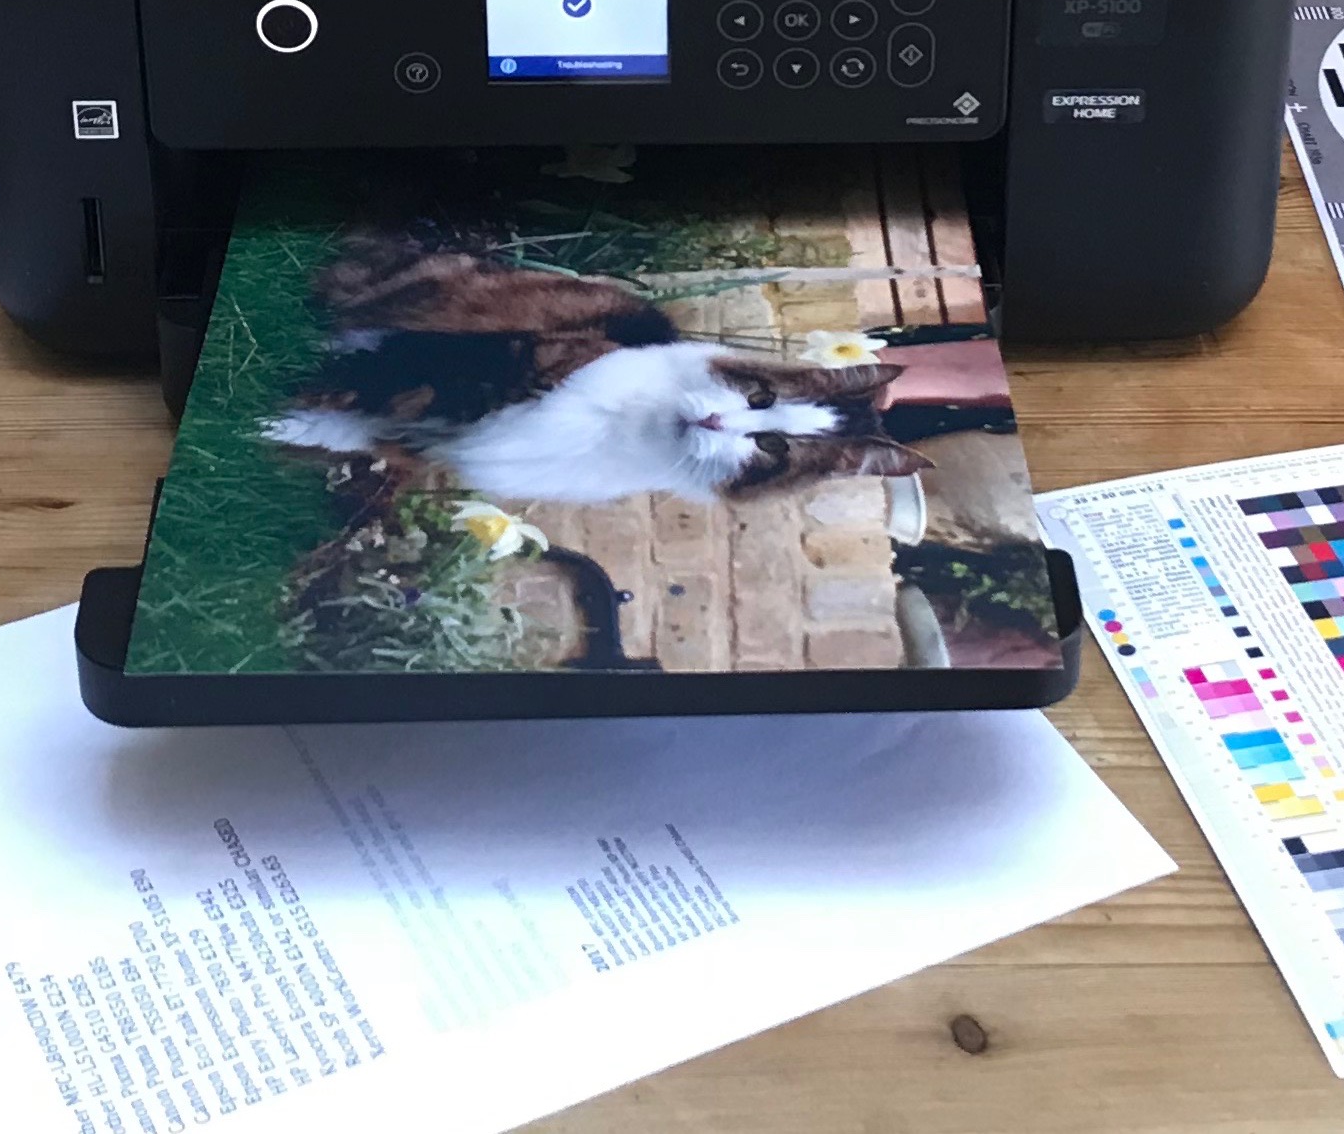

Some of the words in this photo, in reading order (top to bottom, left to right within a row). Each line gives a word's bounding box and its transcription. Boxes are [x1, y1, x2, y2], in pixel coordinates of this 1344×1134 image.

[784, 13, 809, 28] OK
[1063, 0, 1142, 14] XP-5100
[1052, 95, 1141, 106] EXPRESSION
[1073, 108, 1116, 119] HOME
[211, 816, 253, 869] CHASED
[128, 866, 155, 894] £90
[215, 876, 248, 911] £325
[242, 866, 277, 912] similar
[259, 853, 301, 906] £263.63
[140, 892, 182, 950] XP-5105
[194, 886, 226, 922] £342
[266, 910, 285, 928] or
[287, 903, 320, 940] 6515
[126, 919, 158, 955] £700
[186, 927, 219, 962] £129
[272, 925, 305, 962] £142
[86, 954, 118, 991] £185
[116, 956, 143, 983] £84
[172, 946, 203, 988] Home
[579, 942, 611, 974] 2017
[3, 960, 33, 995] £479
[38, 972, 68, 1009] £234
[65, 972, 97, 1009] £285
[143, 953, 186, 1012] ET-7750
[204, 960, 236, 999] 7830
[248, 981, 271, 1010] Pro
[273, 973, 307, 1023] Ecosys
[82, 1007, 118, 1054] G4510
[192, 985, 241, 1063] Expression
[227, 995, 258, 1039] Photo
[316, 1009, 341, 1029] SP
[53, 1007, 109, 1098] HL-L5100DN
[173, 1008, 215, 1072] EcoTank
[247, 1037, 277, 1075] Envy
[298, 1019, 338, 1079] Kyocera
[330, 1025, 363, 1070] Ricoh
[206, 1068, 238, 1116] Epson
[230, 1059, 263, 1107] Epson
[262, 1074, 289, 1097] HP
[287, 1065, 313, 1088] HP
[131, 1098, 158, 1134] anon
[156, 1088, 186, 1134] Canon
[179, 1077, 212, 1125] Canon
